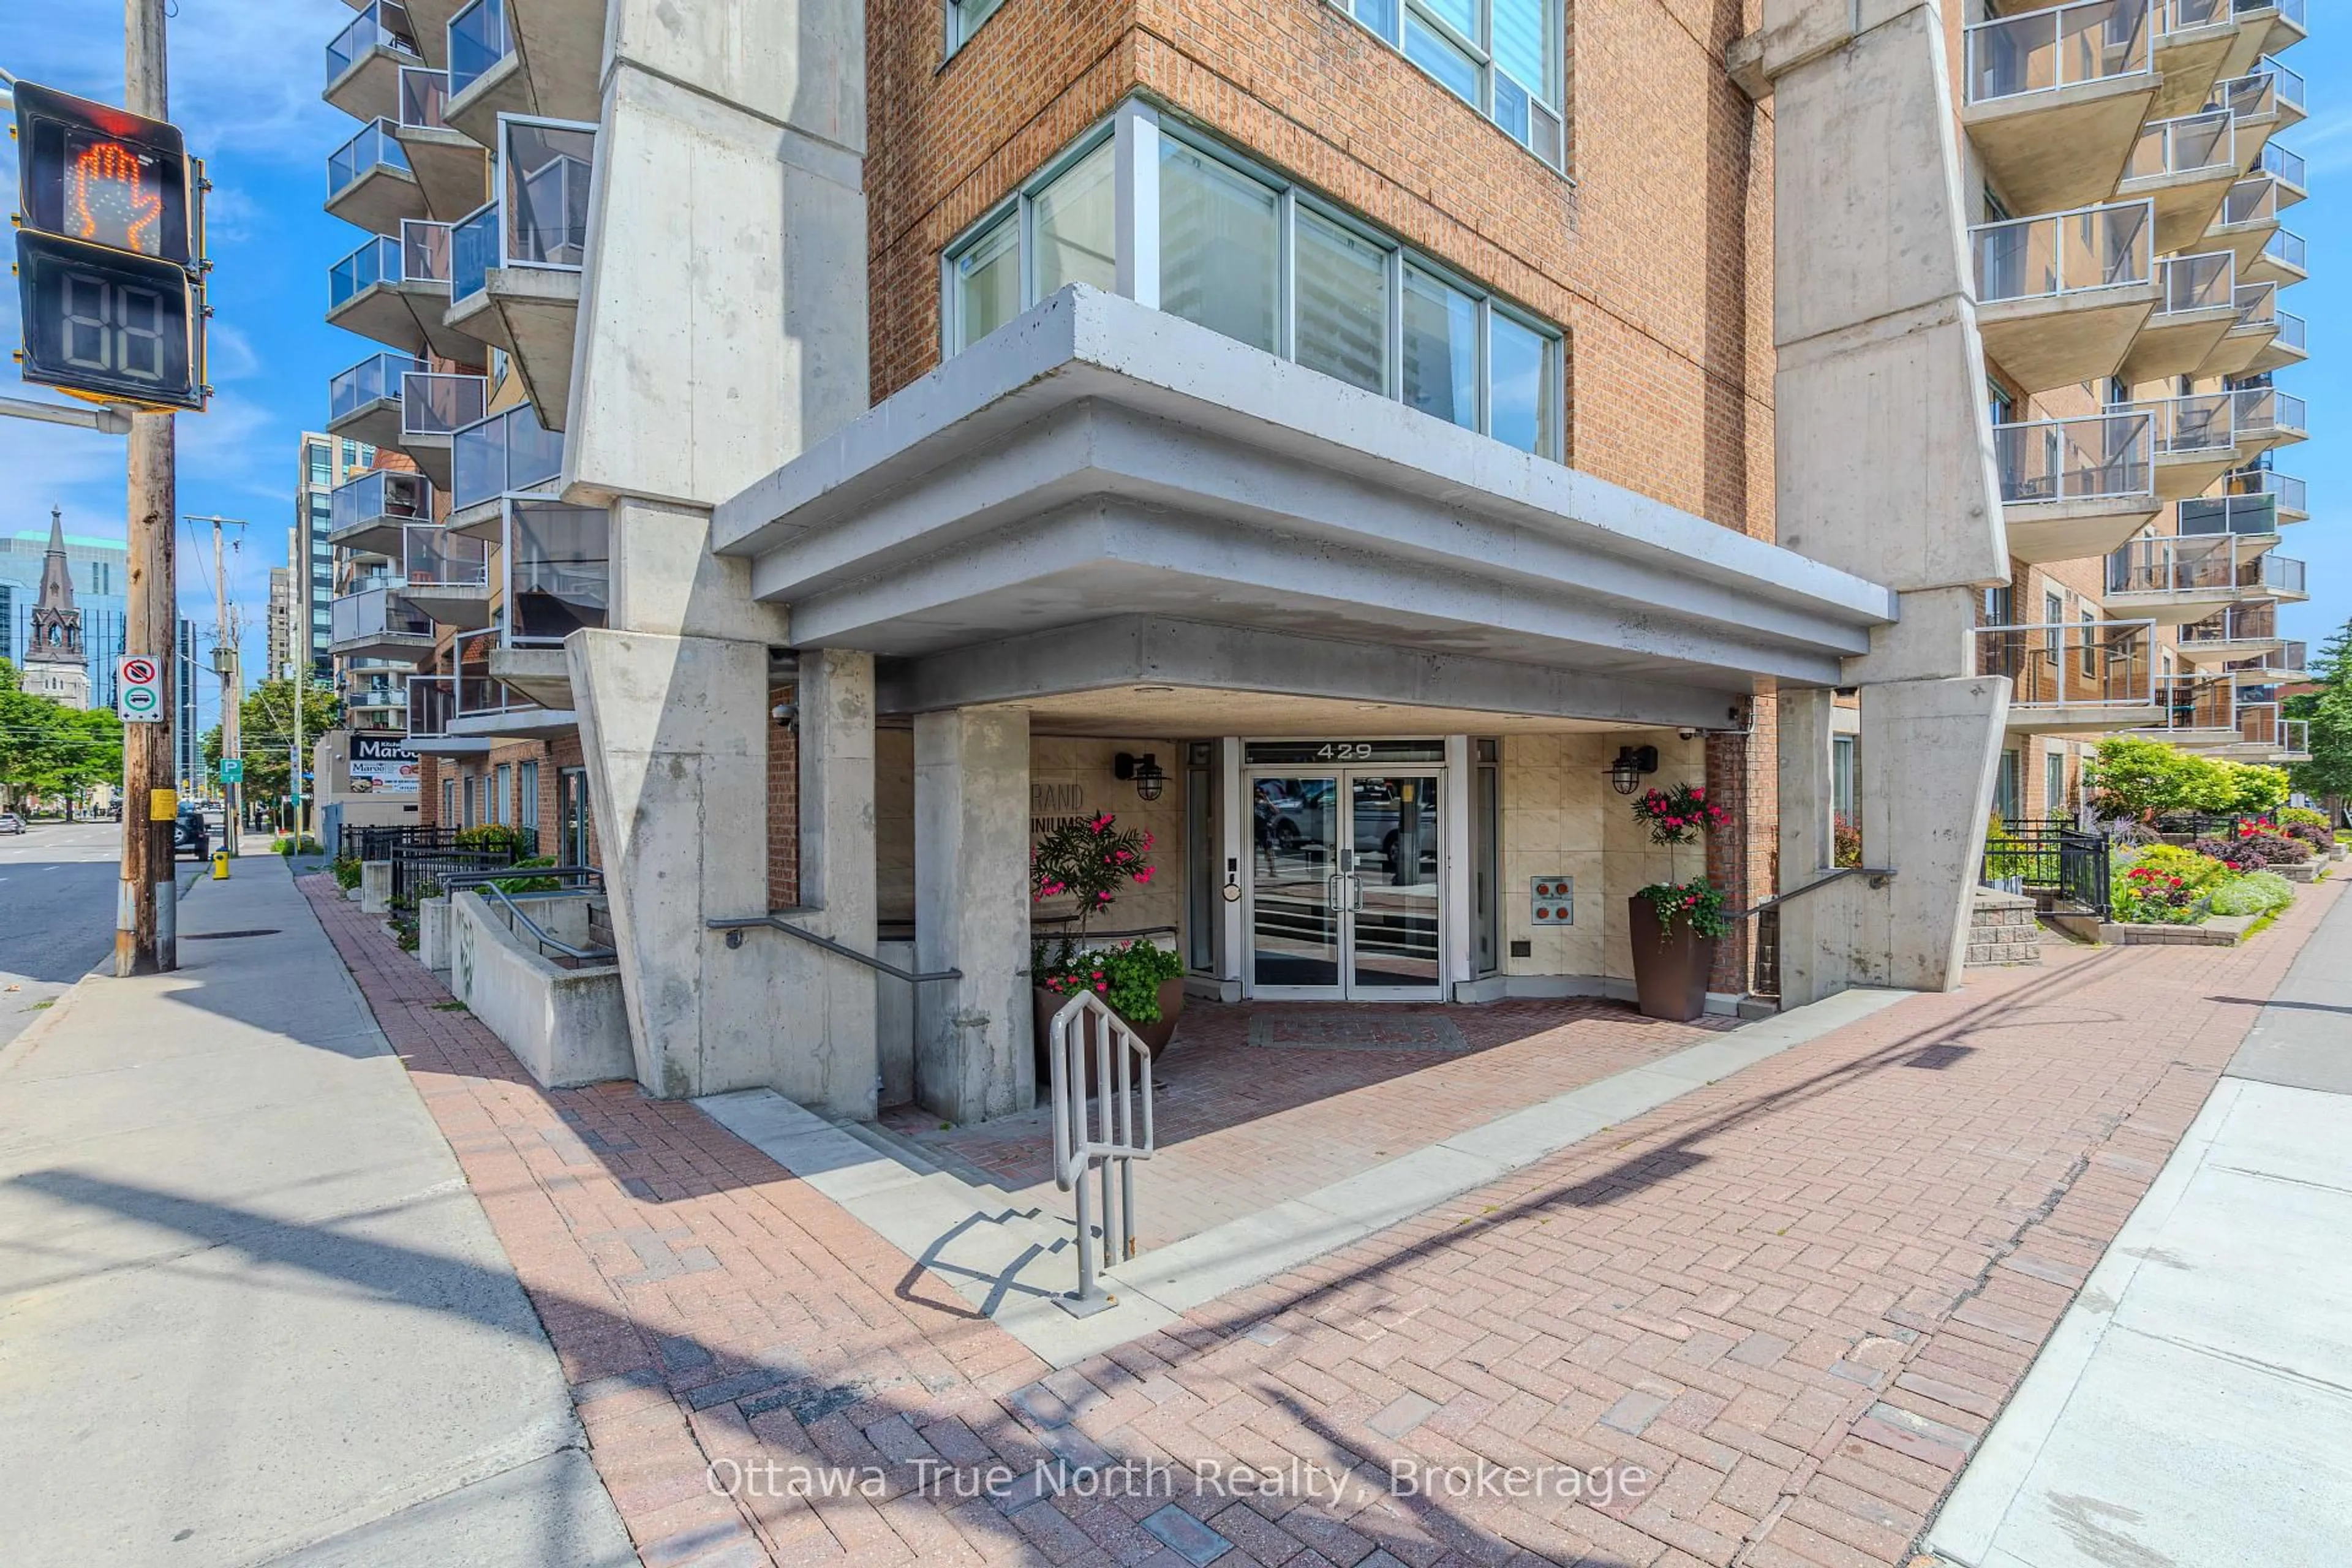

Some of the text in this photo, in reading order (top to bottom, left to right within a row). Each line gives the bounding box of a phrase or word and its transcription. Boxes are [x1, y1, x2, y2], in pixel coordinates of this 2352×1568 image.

[1317, 744, 1371, 759] 429
[225, 761, 238, 773] P
[1031, 784, 1083, 811] RAND
